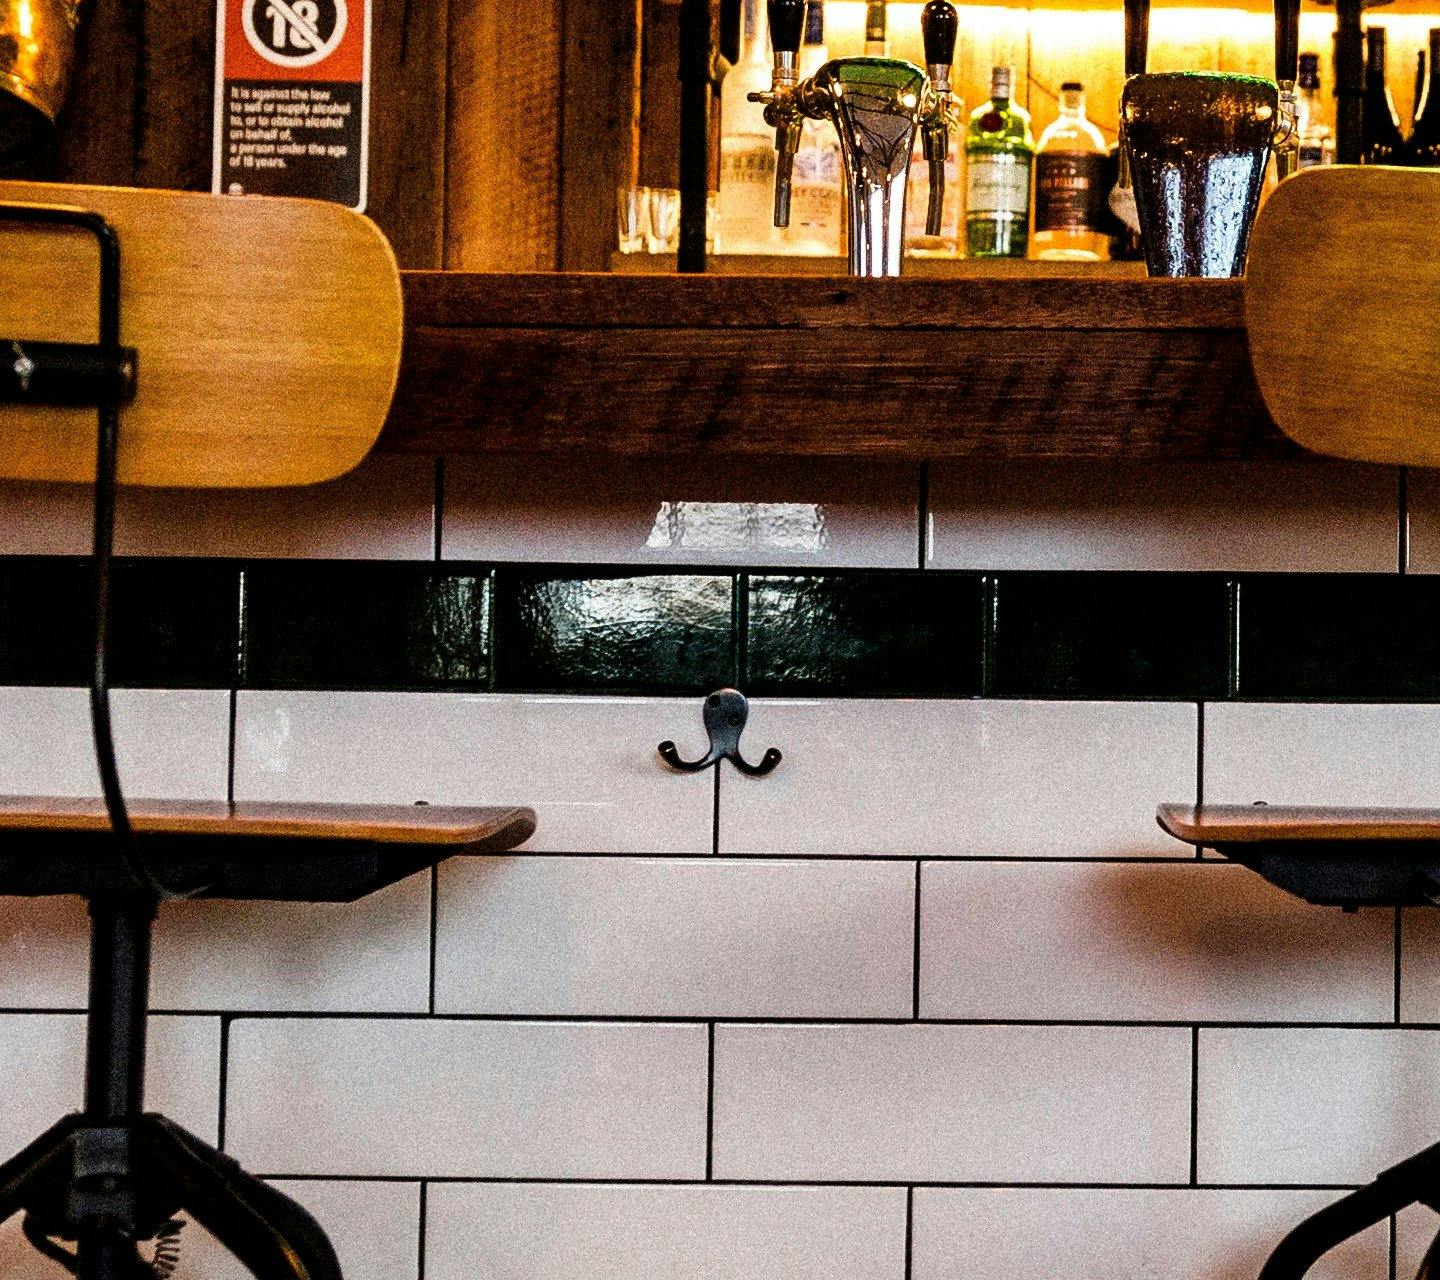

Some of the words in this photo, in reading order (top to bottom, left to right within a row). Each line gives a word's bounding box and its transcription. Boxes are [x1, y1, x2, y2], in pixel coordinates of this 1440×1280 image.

[265, 0, 319, 48] 18
[231, 87, 239, 99] It
[240, 87, 250, 99] is
[252, 87, 290, 102] against
[291, 88, 309, 100] the
[310, 88, 331, 100] law
[230, 102, 242, 113] to
[244, 102, 262, 113] sell
[263, 103, 275, 113] or
[276, 103, 310, 116] supply
[312, 102, 351, 115] alcohol
[245, 116, 256, 126] or
[258, 116, 269, 127] to
[270, 116, 303, 127] obtain
[305, 117, 344, 128] alcohol
[230, 129, 244, 140] on
[245, 128, 278, 140] behalf
[230, 144, 237, 154] a
[239, 144, 275, 156] person
[276, 143, 306, 154] under
[308, 144, 326, 155] the
[327, 145, 348, 158] age
[229, 156, 240, 167] of
[243, 156, 254, 167] 18
